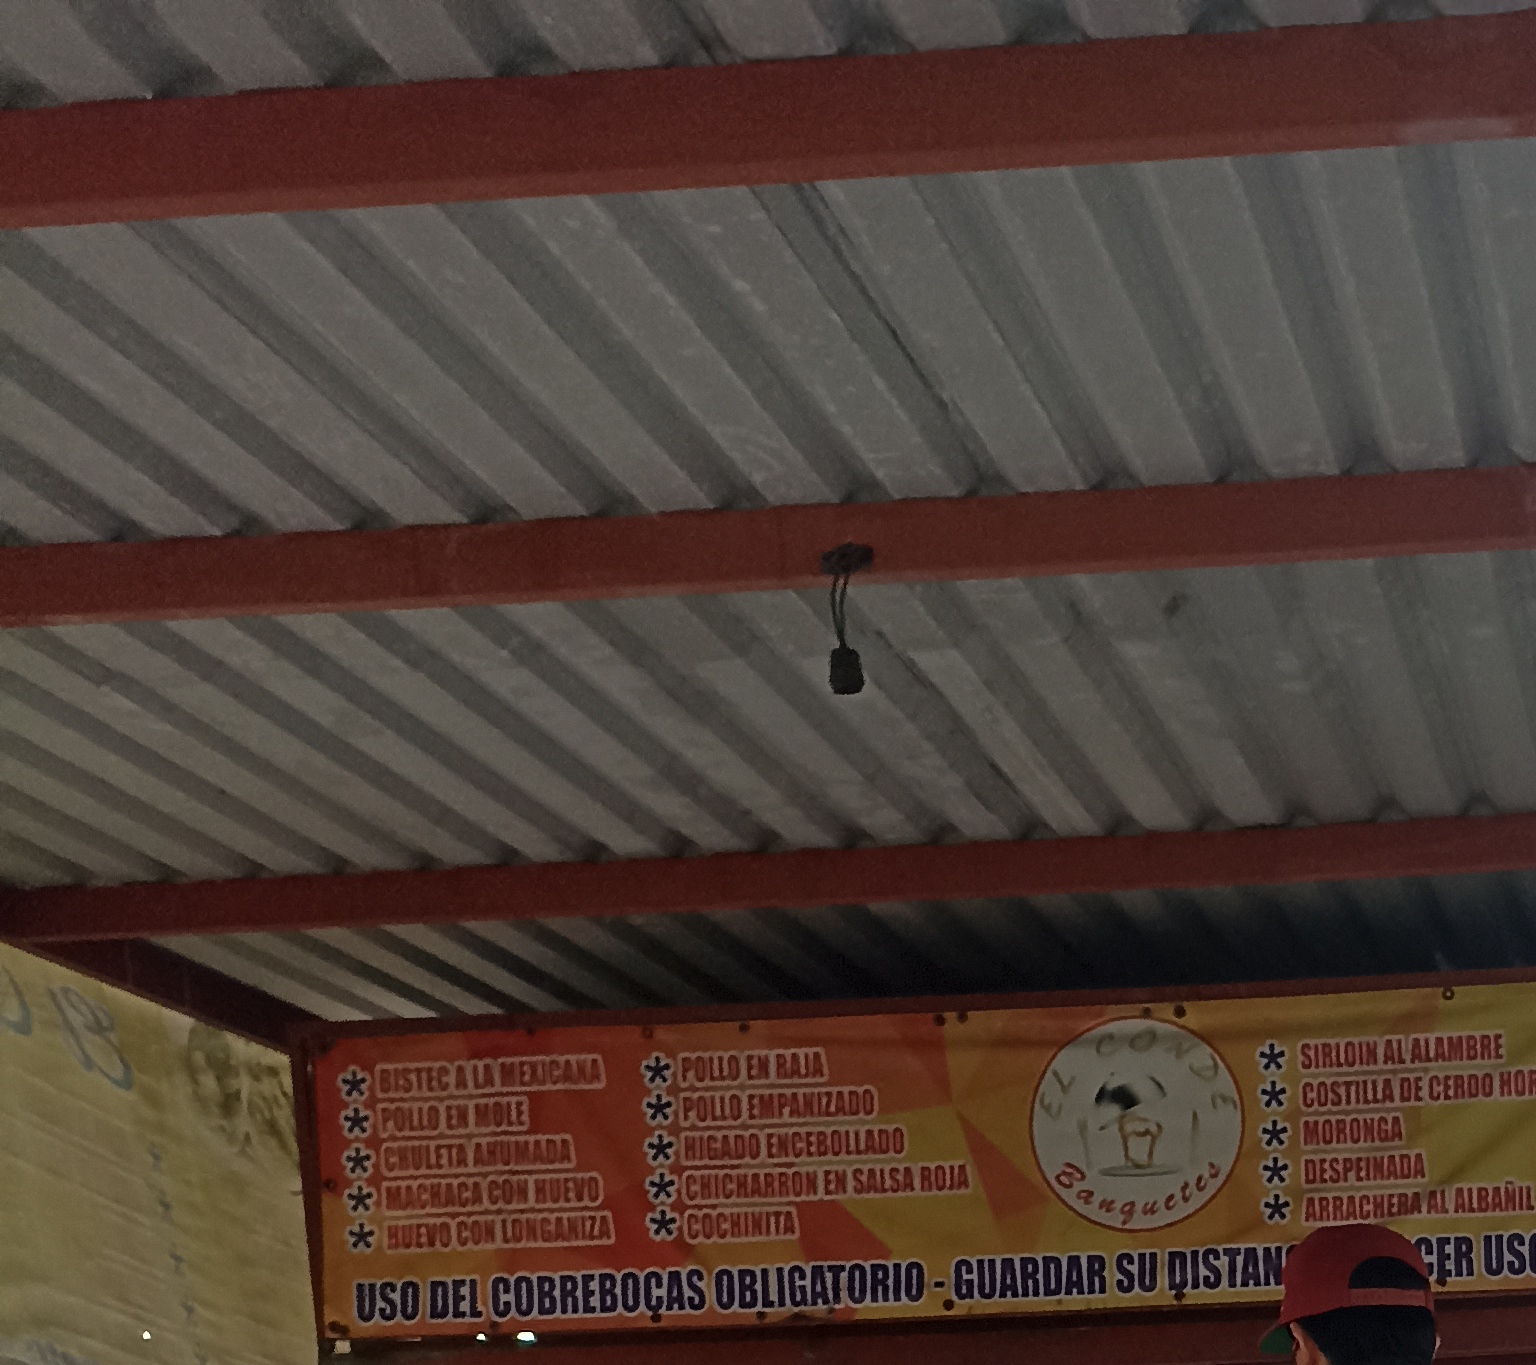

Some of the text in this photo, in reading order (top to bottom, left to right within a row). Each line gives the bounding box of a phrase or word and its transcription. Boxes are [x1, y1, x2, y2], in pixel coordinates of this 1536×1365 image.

[682, 1051, 824, 1083] POLLO EN RAJA
[1301, 1033, 1504, 1070] SIRLOIN AL ALAMBRE
[379, 1056, 601, 1094] BISTEC A LA MEXICANA
[1302, 1077, 1395, 1109] COSTILLA
[1400, 1075, 1423, 1102] DE
[1428, 1073, 1494, 1101] CERDO
[381, 1099, 525, 1134] POLLO EN MOLE
[684, 1088, 876, 1124] POLLO EMPANIZADO
[684, 1127, 905, 1163] HIGADO ENCEBOLLADO
[1303, 1116, 1403, 1147] MORONGA
[384, 1137, 572, 1174] CHULETA AHUMADA
[1304, 1152, 1426, 1185] DESPEINADA
[386, 1175, 600, 1212] MACHACA CON HUEVO
[686, 1164, 969, 1201] CHICHARRON EN SALSA ROJA
[1305, 1181, 1535, 1223] ARRACHERA AL ALBAÑIL
[387, 1214, 611, 1250] HUEVO CON LONGANIZA
[687, 1209, 796, 1241] COCHINITA
[356, 1281, 420, 1323] USO
[429, 1279, 482, 1320] DEL
[491, 1269, 706, 1318] COBREBOCAS
[715, 1261, 926, 1313] OBLIGATORIO
[954, 1254, 1106, 1301] GUARDAR
[1116, 1251, 1158, 1293] SU
[1168, 1244, 1297, 1291] DISTAN
